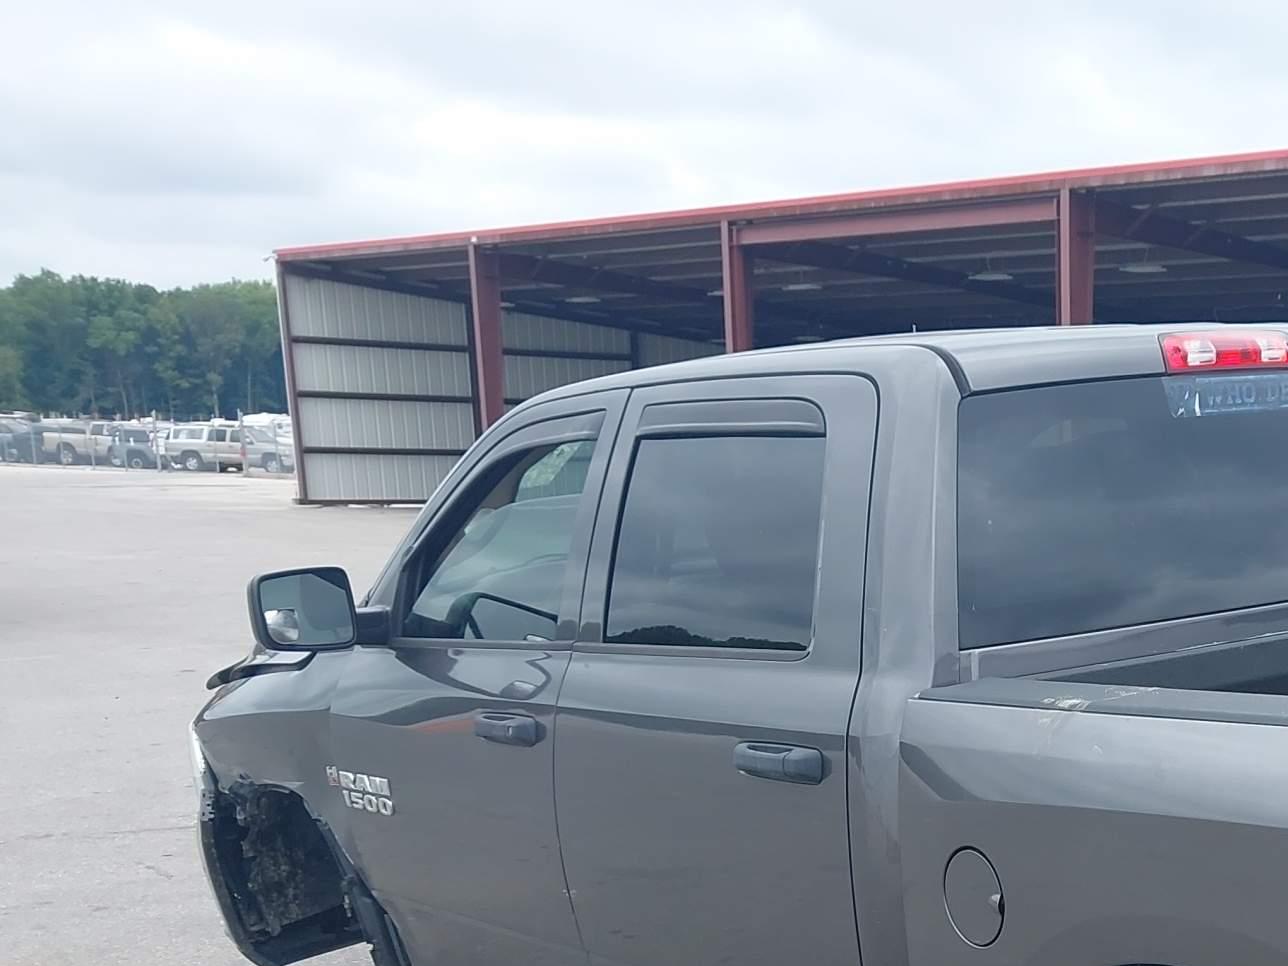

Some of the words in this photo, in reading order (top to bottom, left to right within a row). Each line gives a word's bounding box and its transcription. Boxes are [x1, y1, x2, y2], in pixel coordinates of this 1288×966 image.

[1207, 383, 1256, 405] WHO
[338, 770, 391, 797] RAM
[342, 790, 394, 816] 1500
